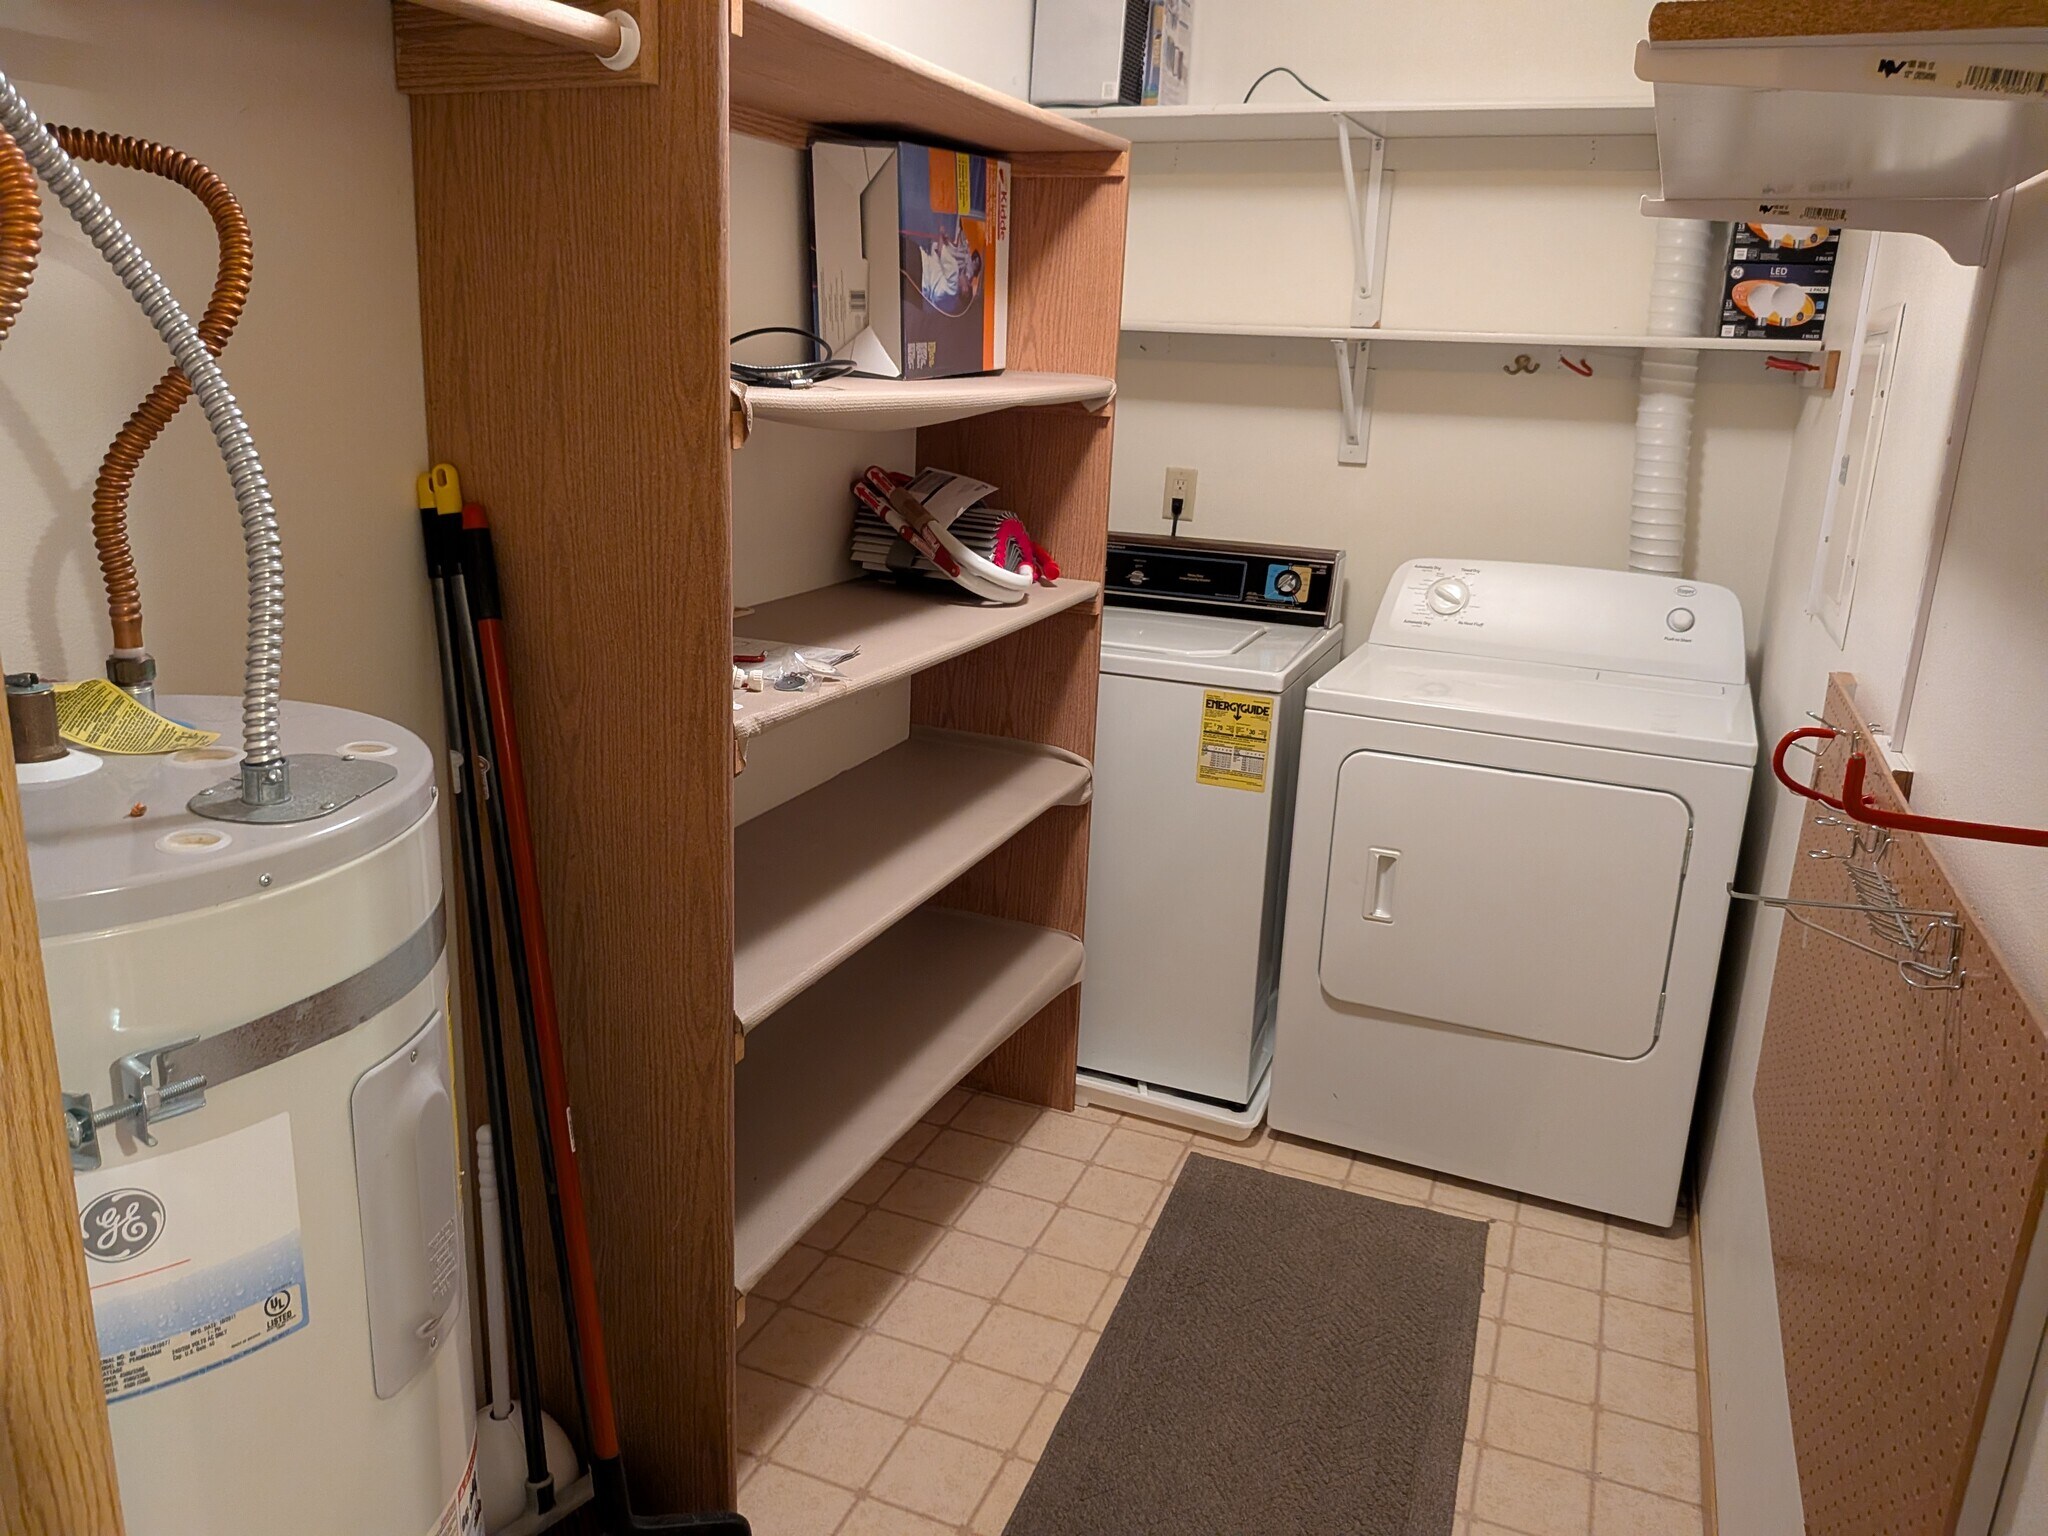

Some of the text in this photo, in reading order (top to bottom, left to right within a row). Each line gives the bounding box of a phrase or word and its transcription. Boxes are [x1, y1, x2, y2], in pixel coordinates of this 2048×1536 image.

[1770, 267, 1788, 275] LED
[1205, 699, 1270, 717] ENERGYGUIDE
[271, 1297, 285, 1310] UL
[267, 1310, 292, 1329] LISTED
[103, 1367, 122, 1376] ATTAGE
